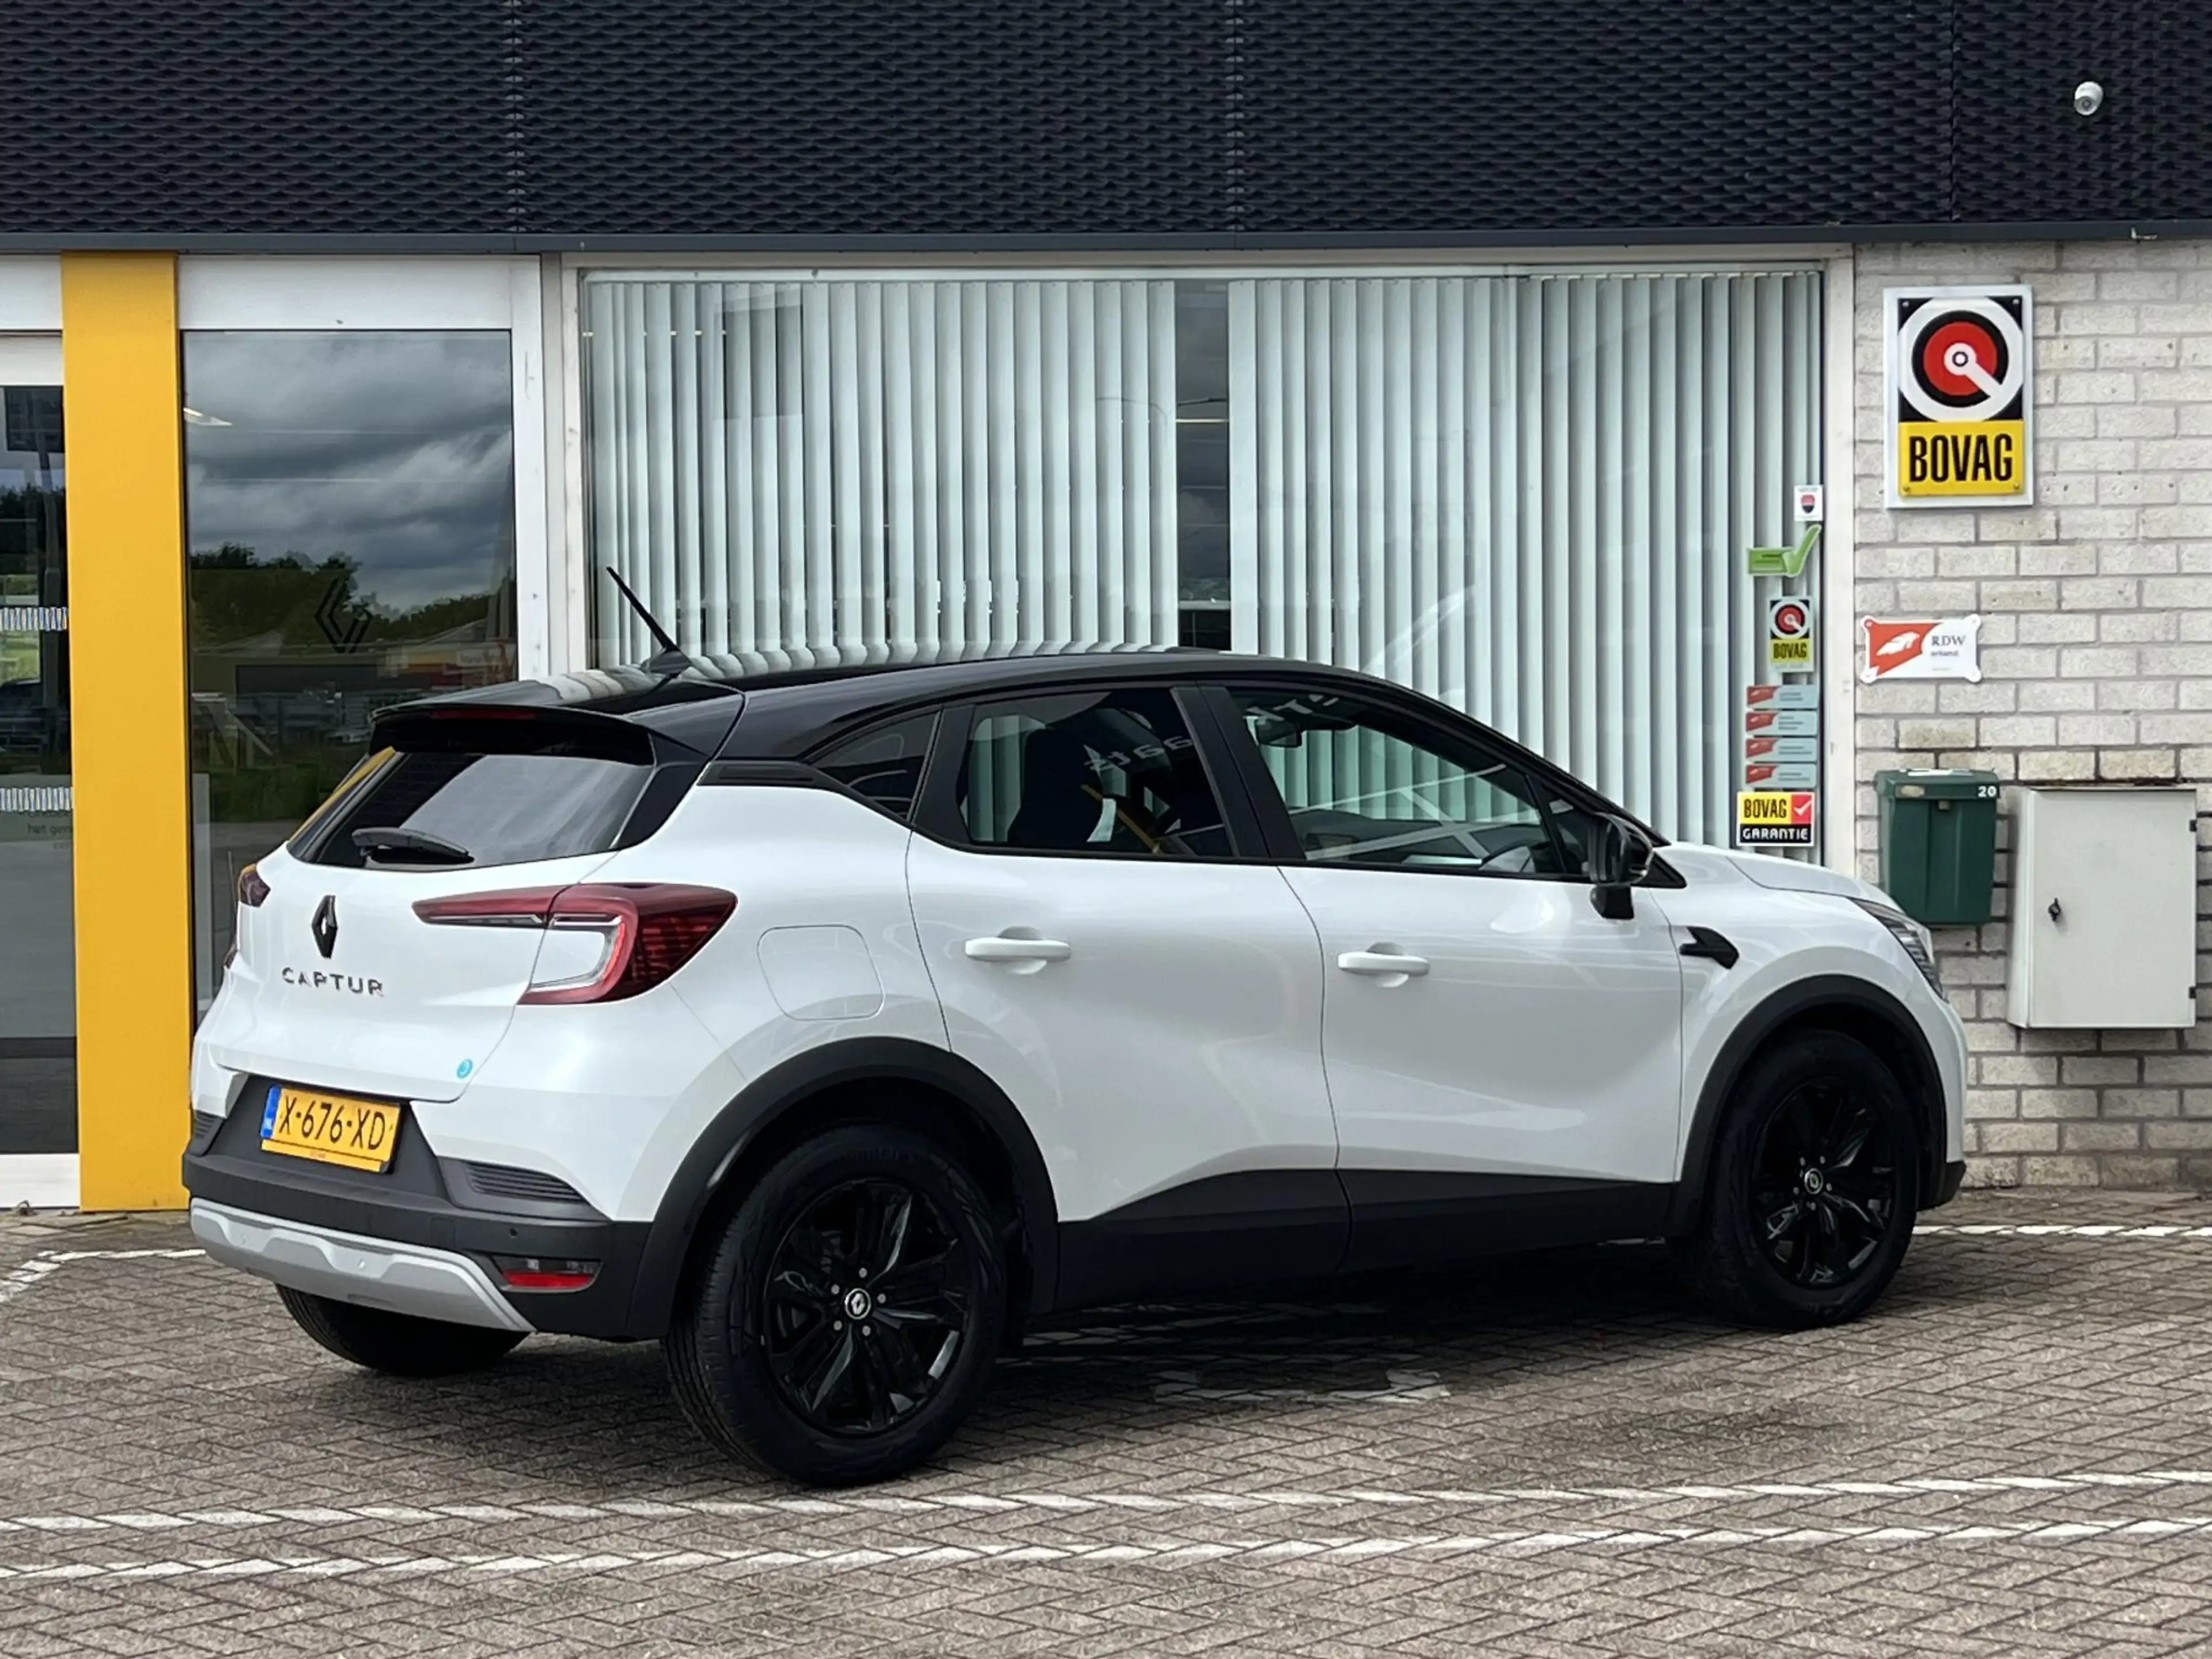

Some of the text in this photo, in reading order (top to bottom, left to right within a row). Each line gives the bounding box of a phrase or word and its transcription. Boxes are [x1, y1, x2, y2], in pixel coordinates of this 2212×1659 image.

[1909, 433, 2012, 482] BOVAG
[1931, 635, 1965, 646] RDW
[1773, 642, 1807, 659] BOVAG
[1978, 786, 1997, 797] 20
[1744, 798, 1787, 819] BOVAG
[1743, 828, 1809, 840] GARANTIE
[282, 967, 384, 997] CAPTUR
[279, 1096, 385, 1150] X-676-XD
